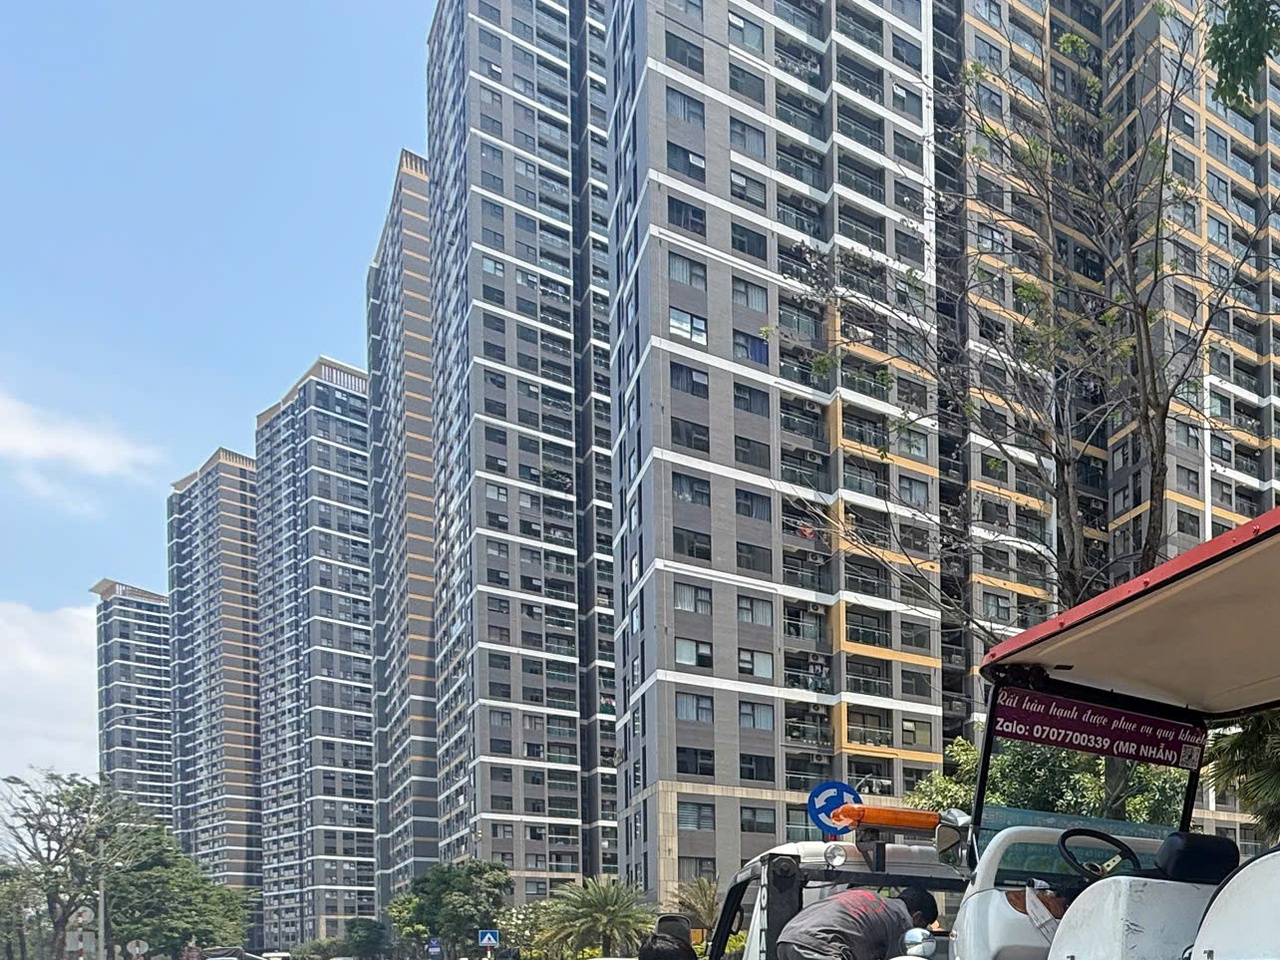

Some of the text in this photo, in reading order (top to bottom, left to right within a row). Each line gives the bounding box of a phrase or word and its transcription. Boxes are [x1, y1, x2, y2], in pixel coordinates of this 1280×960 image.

[995, 717, 1030, 736] Zalo:
[1033, 725, 1111, 750] 0707700339
[1113, 740, 1138, 755] (MR
[1049, 702, 1079, 720] hạnh
[1140, 725, 1153, 737] vụ
[1156, 728, 1175, 741] quý
